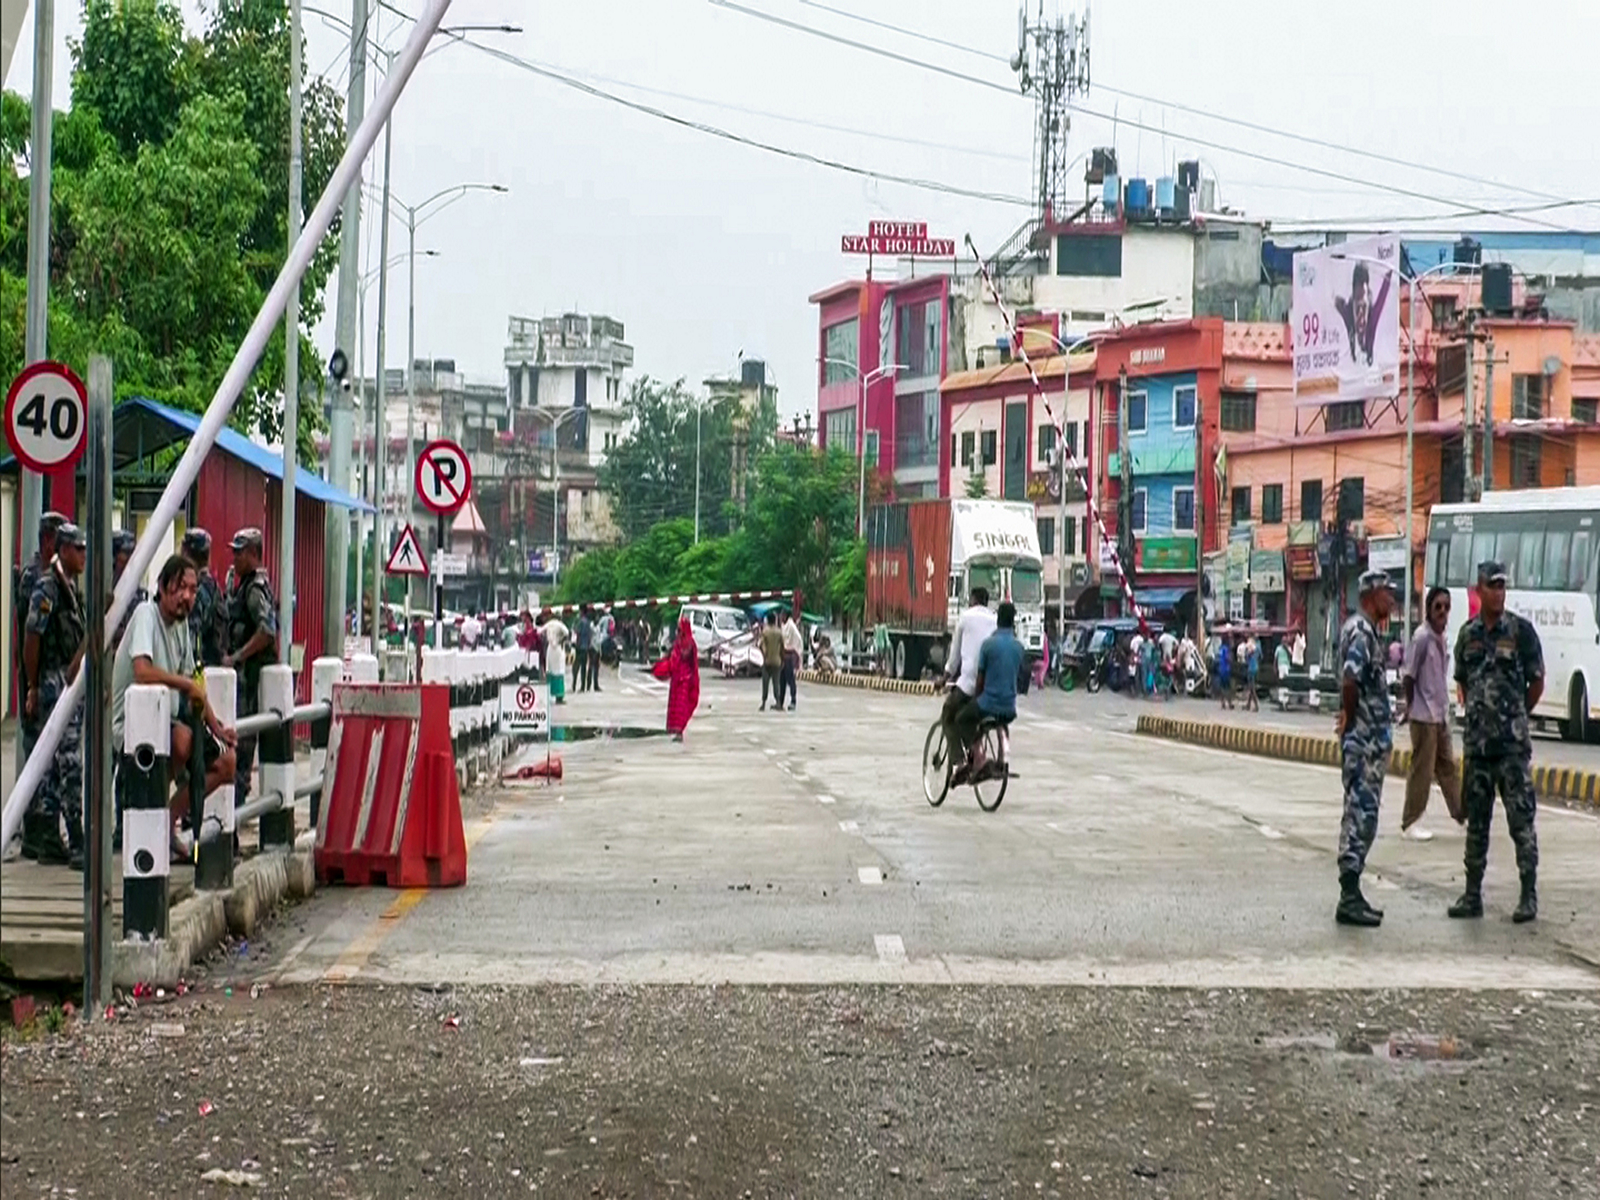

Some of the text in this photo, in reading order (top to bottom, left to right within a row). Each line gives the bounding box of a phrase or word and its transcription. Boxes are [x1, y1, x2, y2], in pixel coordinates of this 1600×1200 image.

[873, 222, 925, 238] HOTEL
[843, 237, 953, 253] STAR HOLIDAY
[1303, 312, 1319, 347] 99
[17, 394, 79, 440] 40
[433, 457, 457, 497] P
[502, 711, 547, 721] NO PARKING
